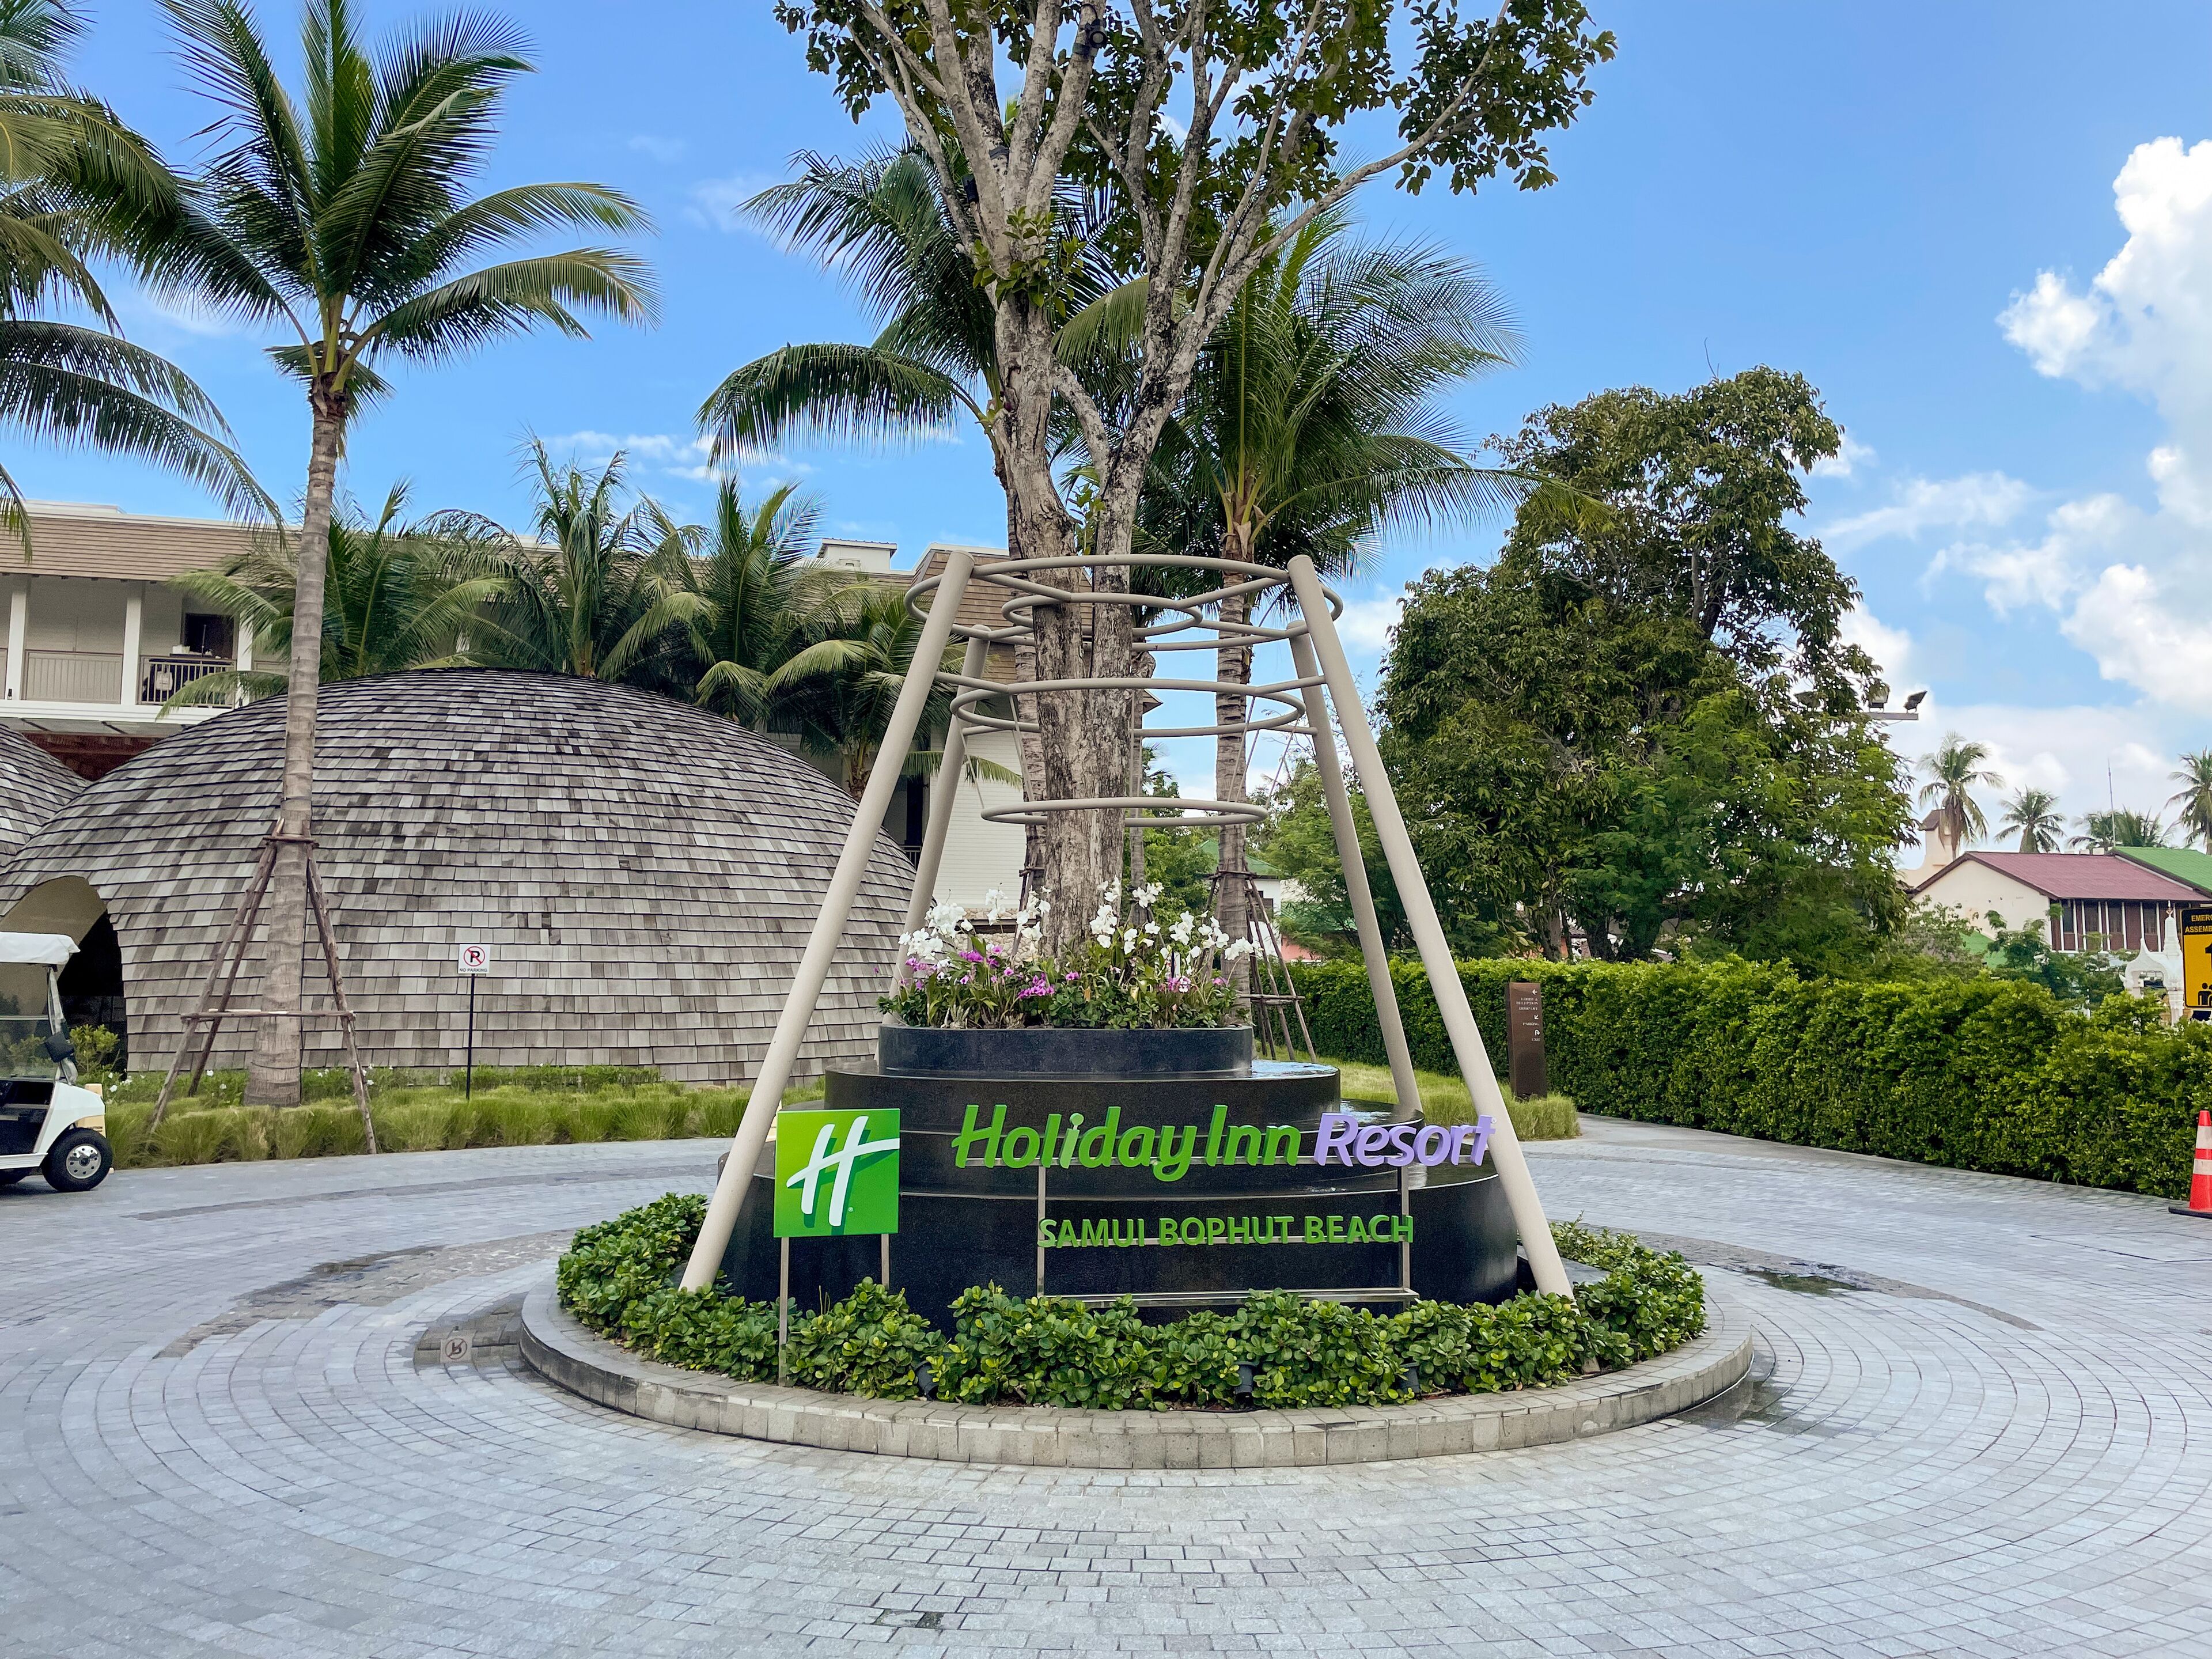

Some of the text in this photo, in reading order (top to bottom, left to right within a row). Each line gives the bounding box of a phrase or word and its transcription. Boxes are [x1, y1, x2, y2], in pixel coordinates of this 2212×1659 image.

[470, 950, 480, 963] P
[950, 1104, 1199, 1182] Holiday
[1204, 1104, 1302, 1166] Inn
[1037, 1214, 1413, 1248] SAMUI BOPHUT BEACH
